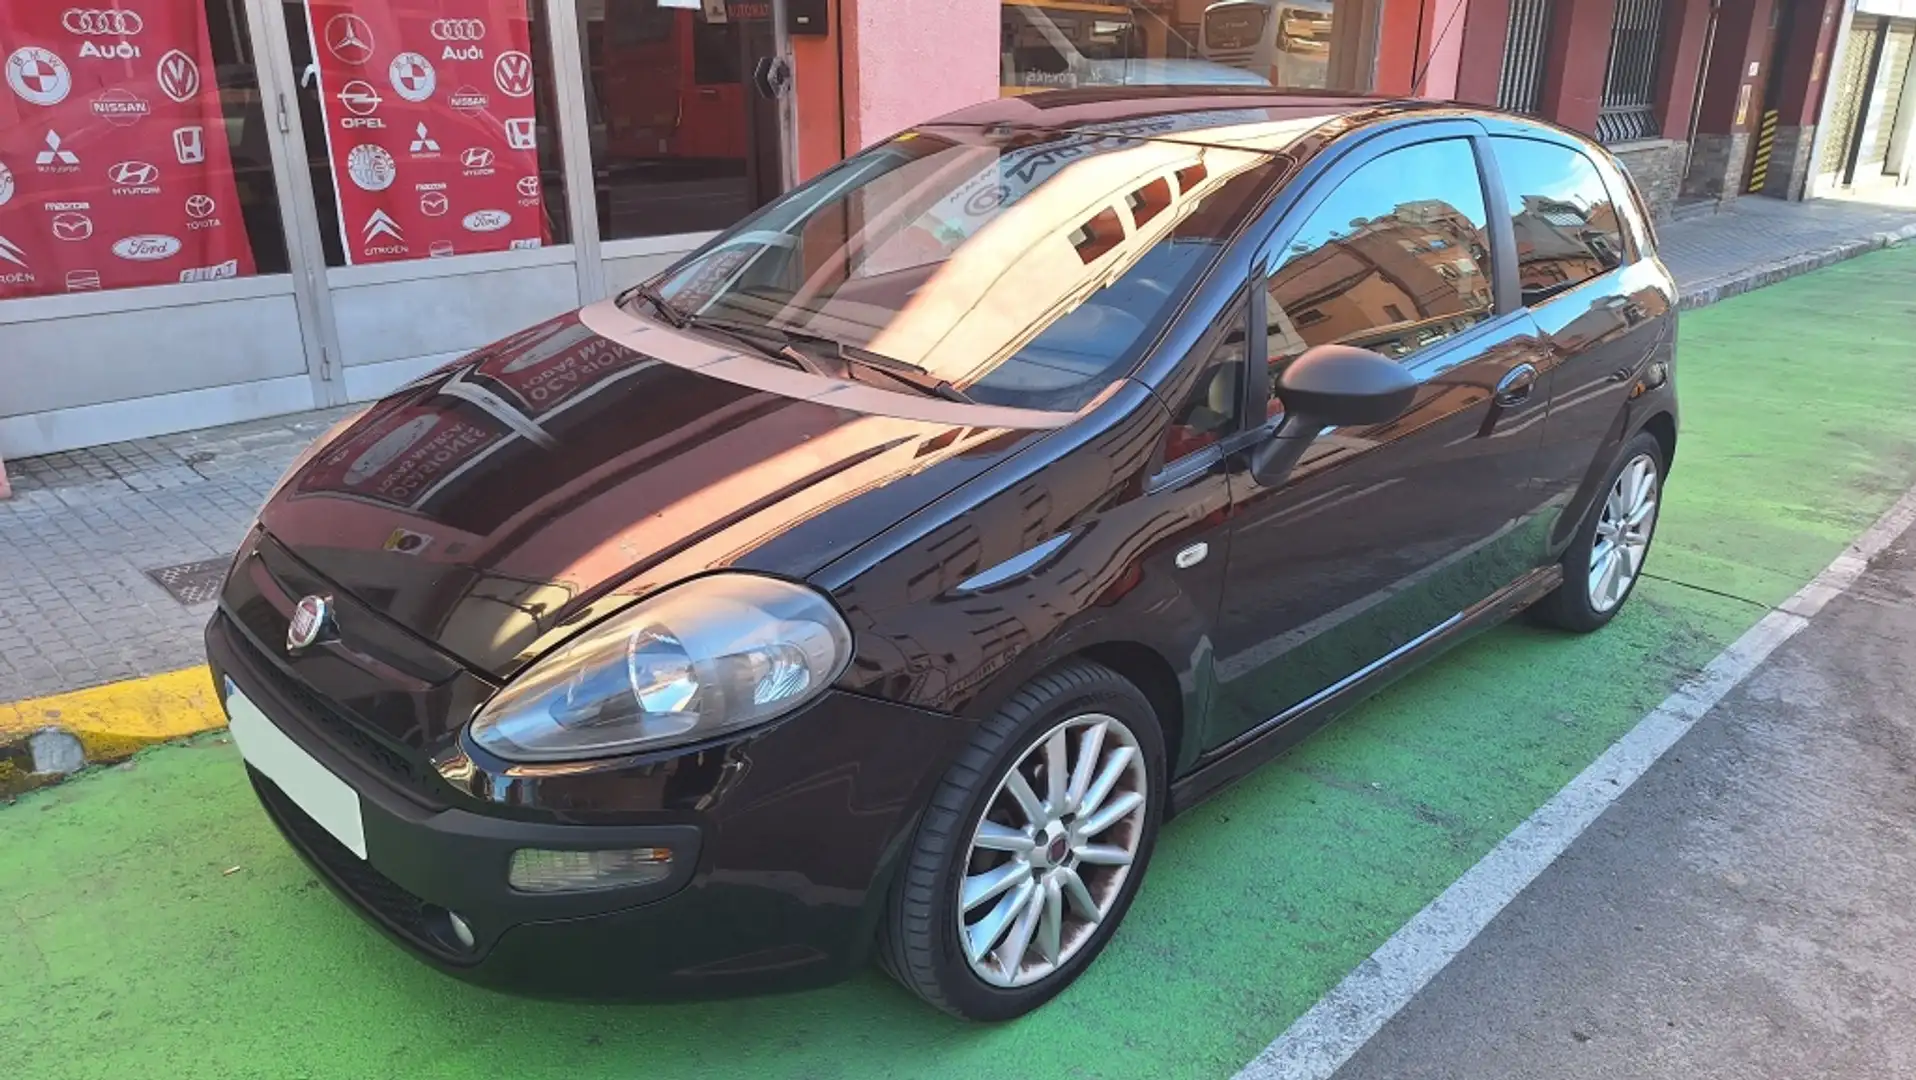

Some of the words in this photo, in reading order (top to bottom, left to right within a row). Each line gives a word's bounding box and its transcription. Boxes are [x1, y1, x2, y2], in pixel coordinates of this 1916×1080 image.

[93, 102, 147, 113] NISSAN
[341, 118, 387, 128] OPEL
[186, 218, 221, 230] TOYOTA
[128, 240, 167, 255] Ford
